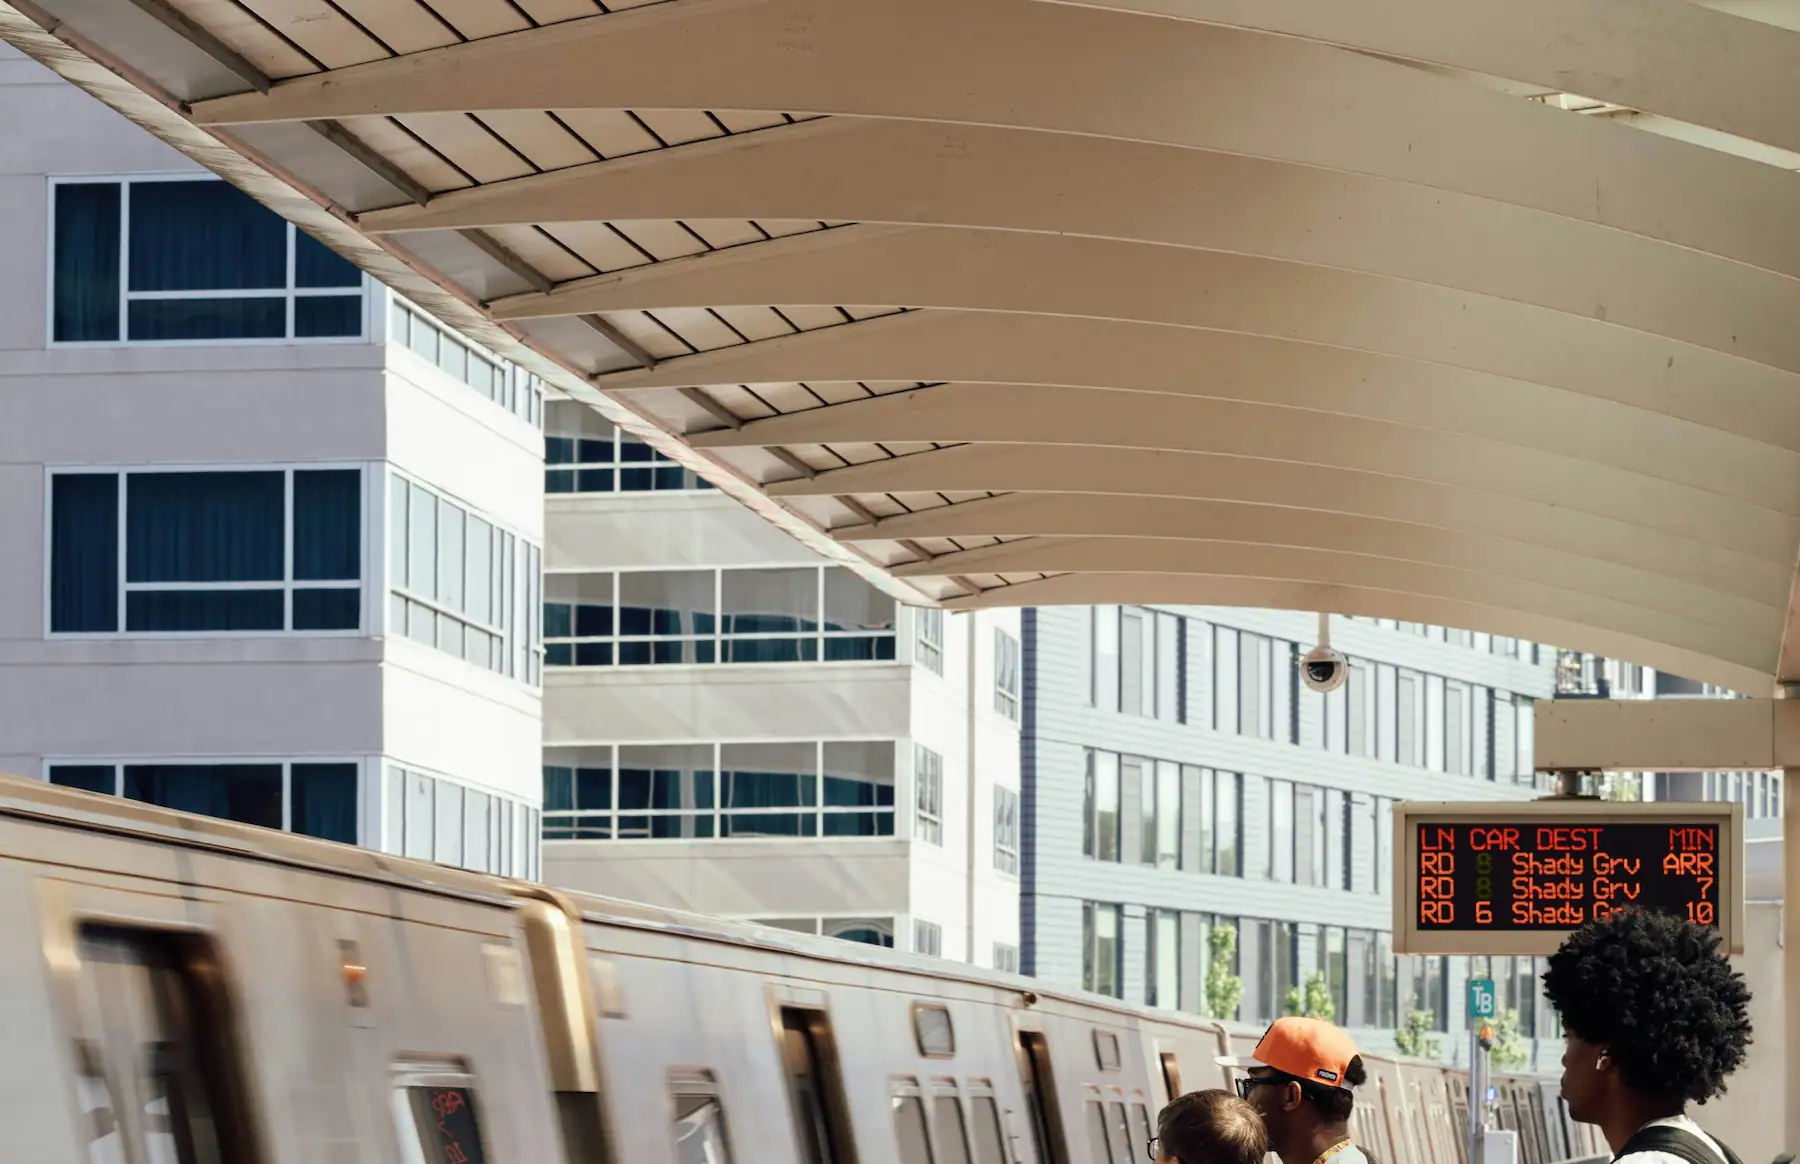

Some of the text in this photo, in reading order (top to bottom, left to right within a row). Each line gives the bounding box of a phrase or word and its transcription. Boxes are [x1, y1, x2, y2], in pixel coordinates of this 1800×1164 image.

[1421, 828, 1714, 850] LN CAR DEST MIN
[1421, 852, 1713, 876] RD 8 Shady Grv ARR
[1421, 876, 1713, 900] RD 8 Shady Grv 7
[1421, 901, 1713, 924] RD 6 Shady Gr 10
